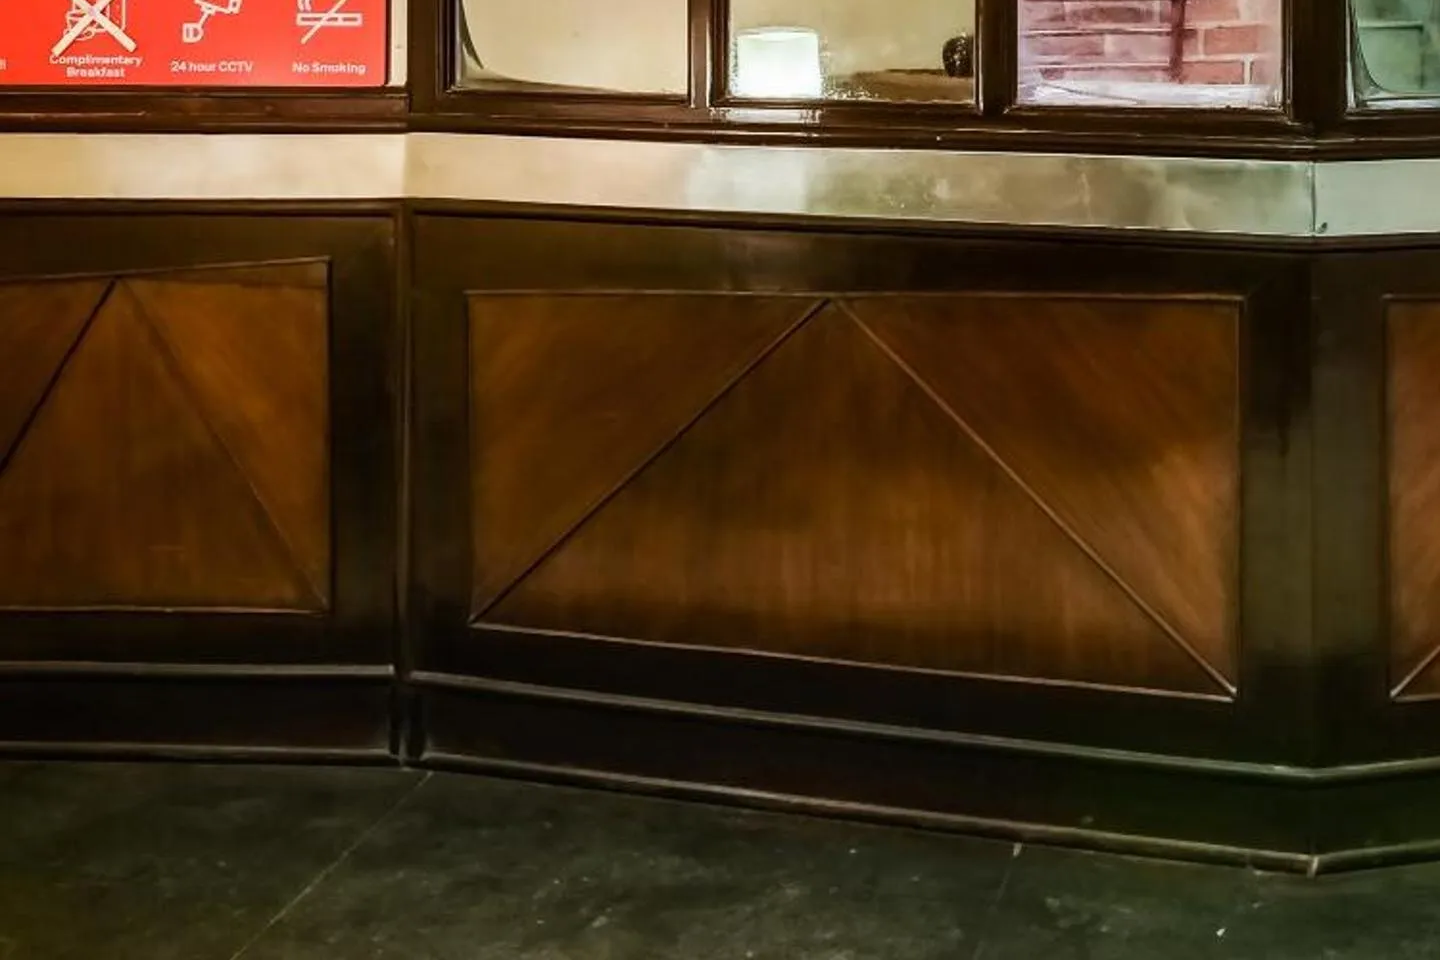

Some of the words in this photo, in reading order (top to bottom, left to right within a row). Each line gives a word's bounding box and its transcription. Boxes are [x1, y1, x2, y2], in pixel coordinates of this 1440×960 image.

[49, 54, 143, 67] Complimentary
[170, 60, 187, 73] 24
[189, 60, 217, 73] hour
[218, 60, 254, 73] CCTV
[66, 66, 125, 78] Breakfast
[292, 61, 310, 74] No
[311, 61, 367, 76] Smoking
